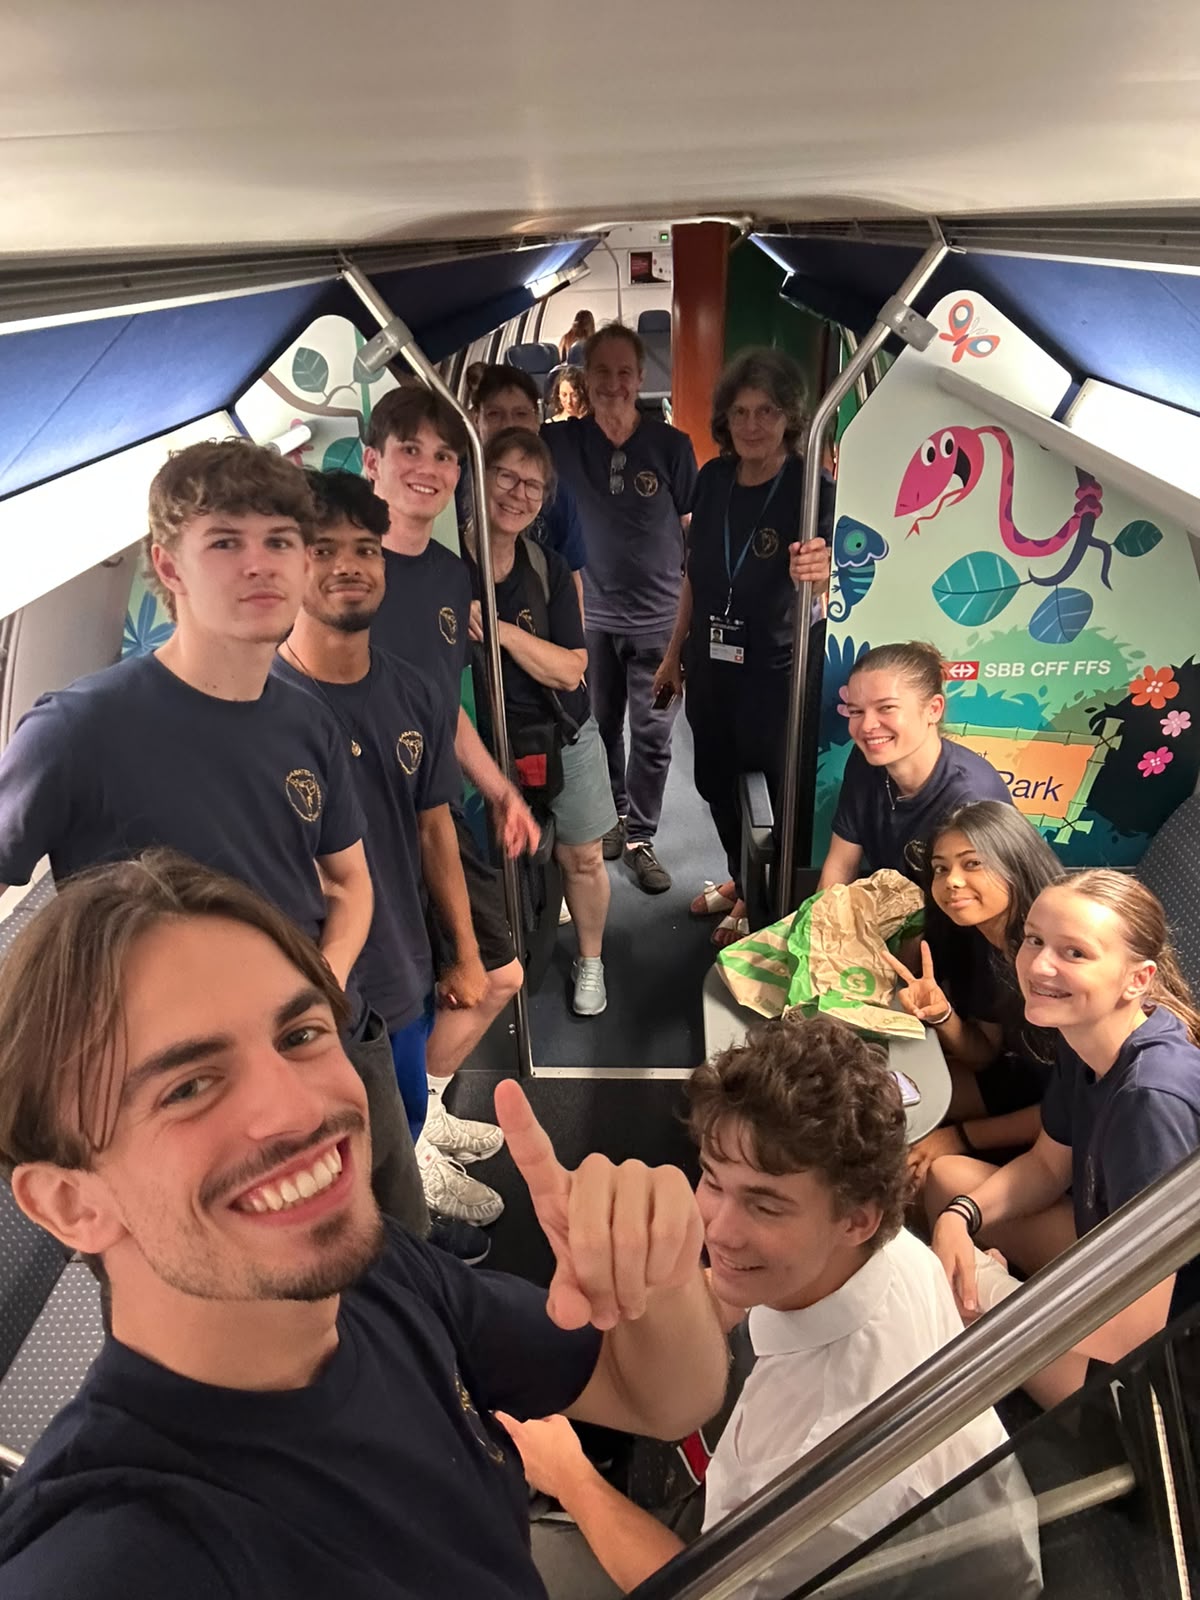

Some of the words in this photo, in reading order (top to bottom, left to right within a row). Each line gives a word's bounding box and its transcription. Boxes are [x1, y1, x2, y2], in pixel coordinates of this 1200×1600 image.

[984, 662, 1025, 678] SBB
[1030, 661, 1070, 677] CFF
[1073, 660, 1111, 675] FFS
